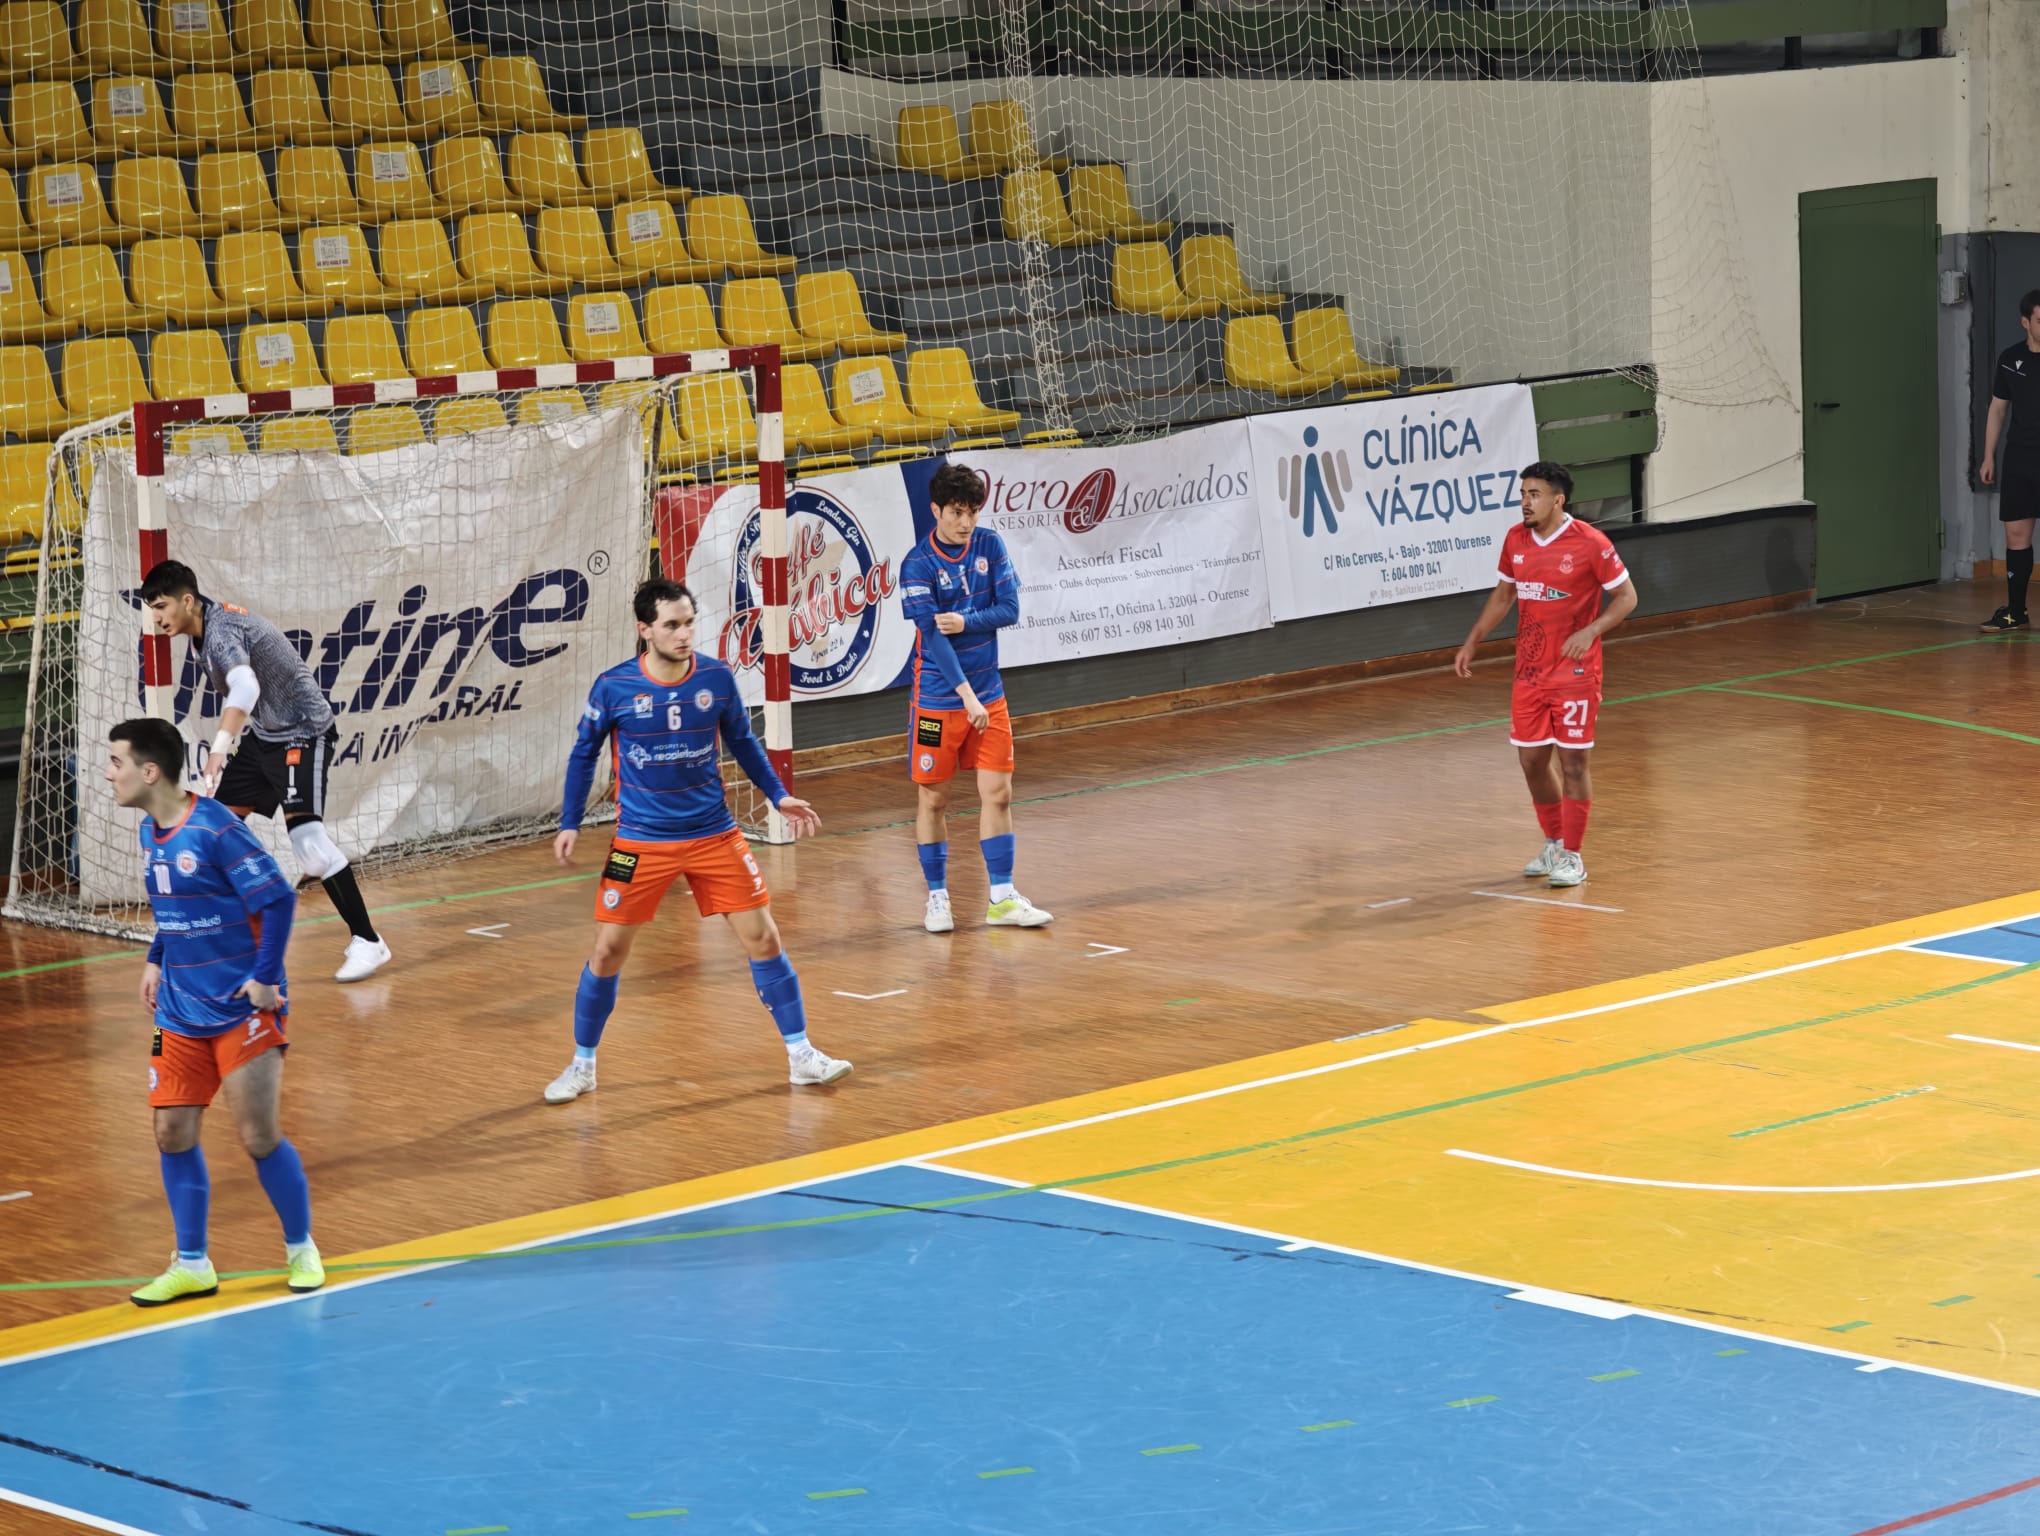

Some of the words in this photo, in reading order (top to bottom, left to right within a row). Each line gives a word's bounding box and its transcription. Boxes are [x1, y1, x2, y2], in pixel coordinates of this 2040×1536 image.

[1106, 464, 1249, 519] Asociados
[1365, 470, 1522, 527] VÁZQUEZ
[816, 500, 847, 529] London
[845, 526, 861, 546] Gin
[1057, 550, 1114, 571] Asesoría
[1119, 543, 1163, 564] Fiscal
[1323, 555, 1334, 571] C/
[1352, 551, 1388, 566] Cerves,
[1388, 547, 1395, 560] 4
[1400, 545, 1421, 560] Bajo
[1426, 538, 1453, 555] 32001
[1454, 535, 1492, 551] Ourense
[1059, 577, 1083, 590] Clubs
[1085, 571, 1128, 587] deportivos
[1134, 563, 1194, 579] Subvenciones
[1201, 556, 1240, 570] Trámites
[1241, 550, 1261, 562] DGT
[1380, 569, 1390, 582] T:
[1391, 566, 1407, 581] 604
[1409, 563, 1424, 578] 009
[1426, 561, 1442, 576] 041
[718, 556, 896, 672] Aábica
[1027, 613, 1066, 629] Buenos
[1068, 609, 1097, 623] Aires
[1099, 605, 1115, 620] 17,
[1116, 600, 1156, 617] Oficina
[1168, 593, 1199, 609] 32004
[1207, 587, 1250, 603] Ourense
[1058, 629, 1079, 646] 988
[1081, 626, 1101, 643] 607
[1103, 623, 1122, 641] 831
[1132, 619, 1153, 636] 698
[1155, 616, 1175, 633] 140
[1176, 613, 1196, 630] 301
[800, 671, 823, 684] Food
[826, 669, 834, 682] &
[836, 652, 858, 678] Drinks
[667, 705, 682, 731] 6
[919, 720, 941, 732] SER
[1563, 699, 1589, 726] 27
[152, 864, 172, 895] 11
[743, 853, 759, 876] 6
